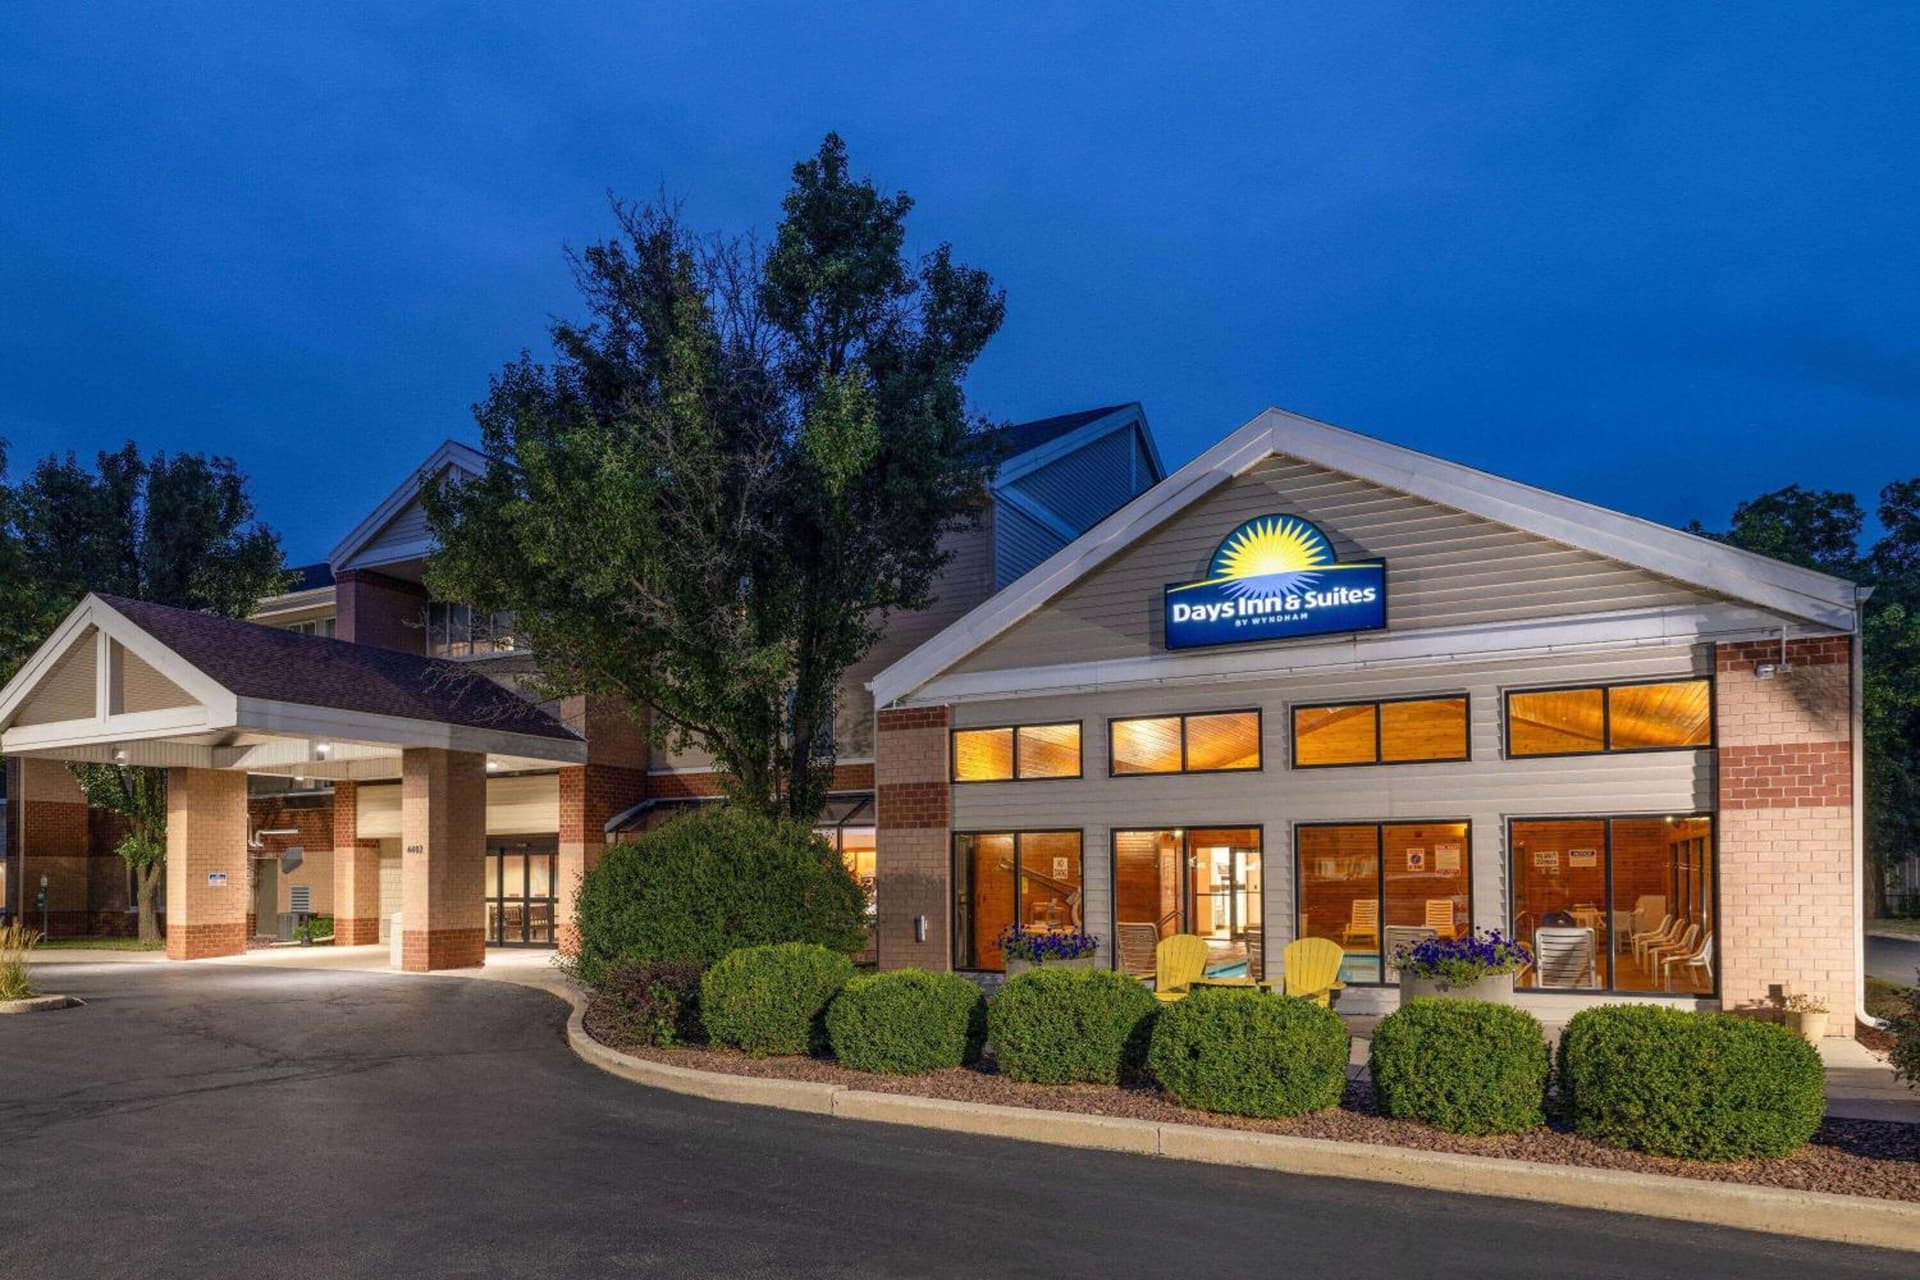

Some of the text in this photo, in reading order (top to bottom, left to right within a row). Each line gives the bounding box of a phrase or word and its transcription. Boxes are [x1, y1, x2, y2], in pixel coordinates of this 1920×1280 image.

[1173, 587, 1376, 623] Days Inn & Suites
[1235, 613, 1308, 627] BY WYNDHAM
